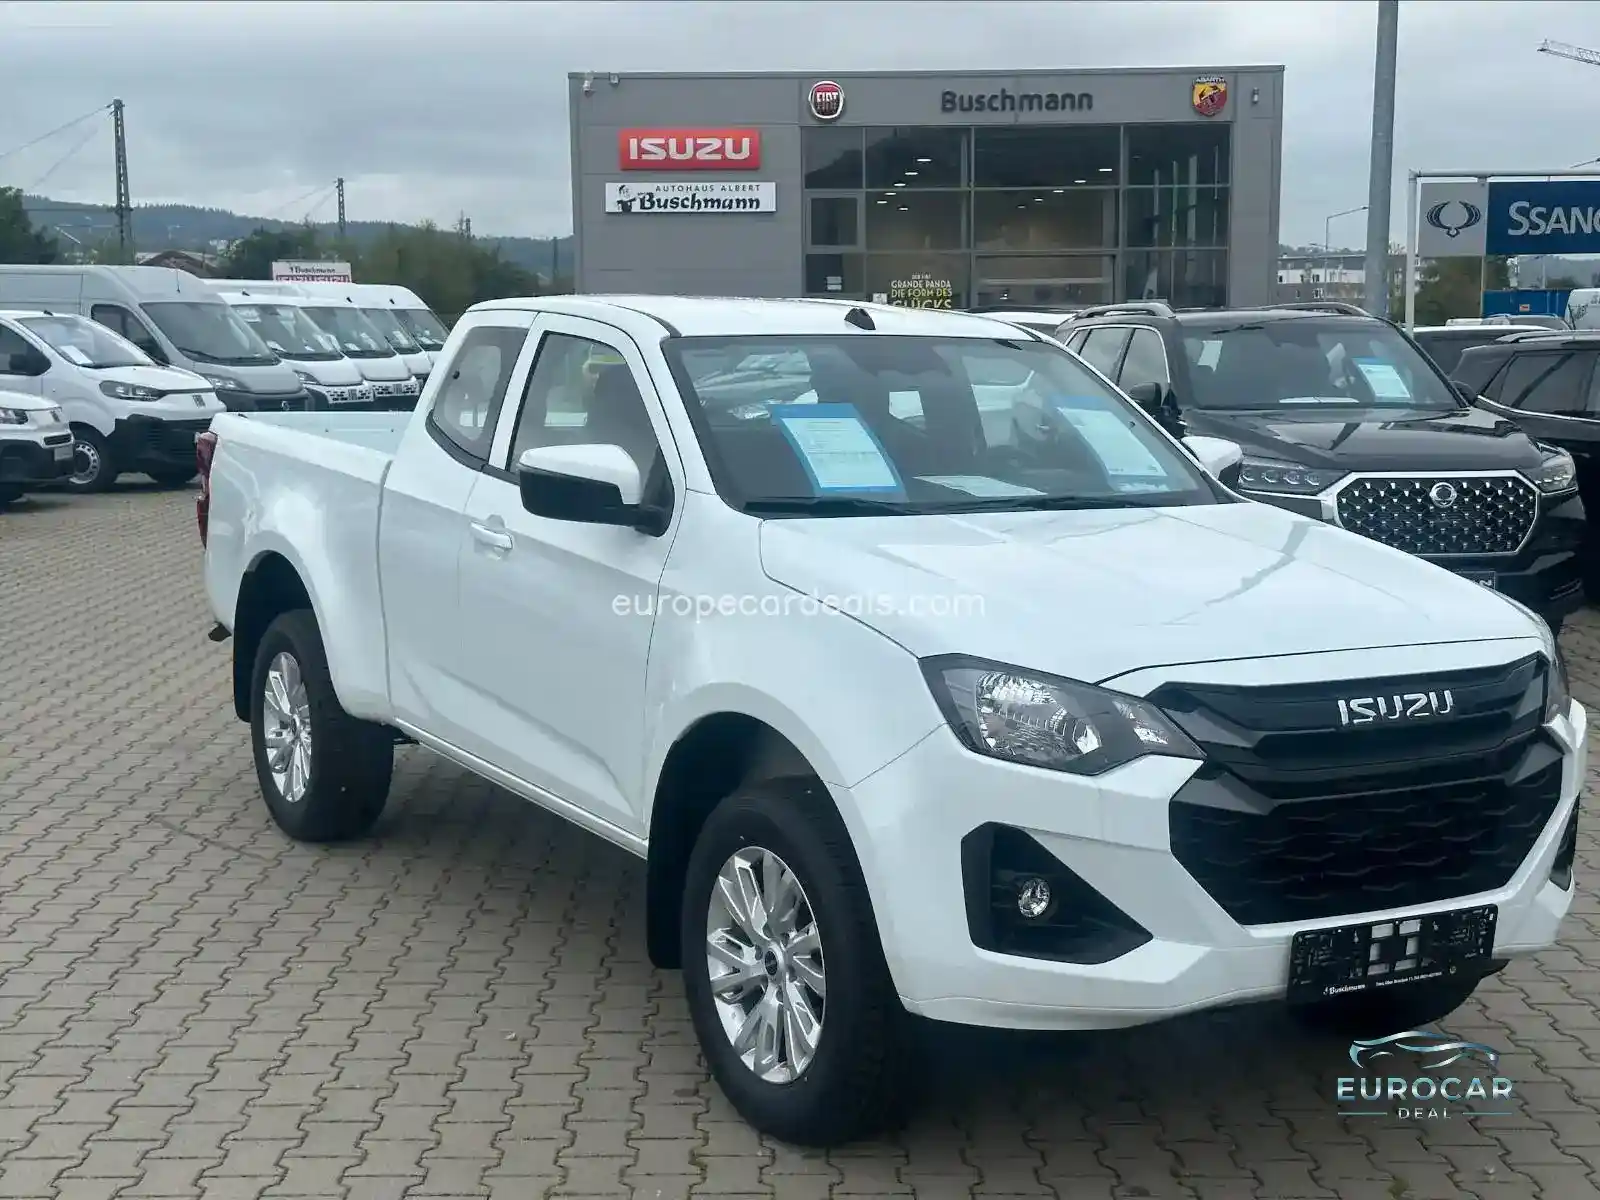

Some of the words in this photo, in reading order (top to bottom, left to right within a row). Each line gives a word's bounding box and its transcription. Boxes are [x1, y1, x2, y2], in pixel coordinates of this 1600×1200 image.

[816, 91, 839, 102] FIAT
[941, 88, 1094, 113] Buschmann
[629, 137, 750, 160] ISUZU
[655, 184, 715, 192] AUTOHAUS
[638, 192, 761, 211] Buschmann
[891, 280, 923, 288] GRANDE
[925, 279, 952, 288] PANDA
[891, 288, 905, 298] DIE
[908, 287, 934, 297] FORM
[936, 287, 953, 297] DES
[1337, 689, 1455, 726] ISUZU
